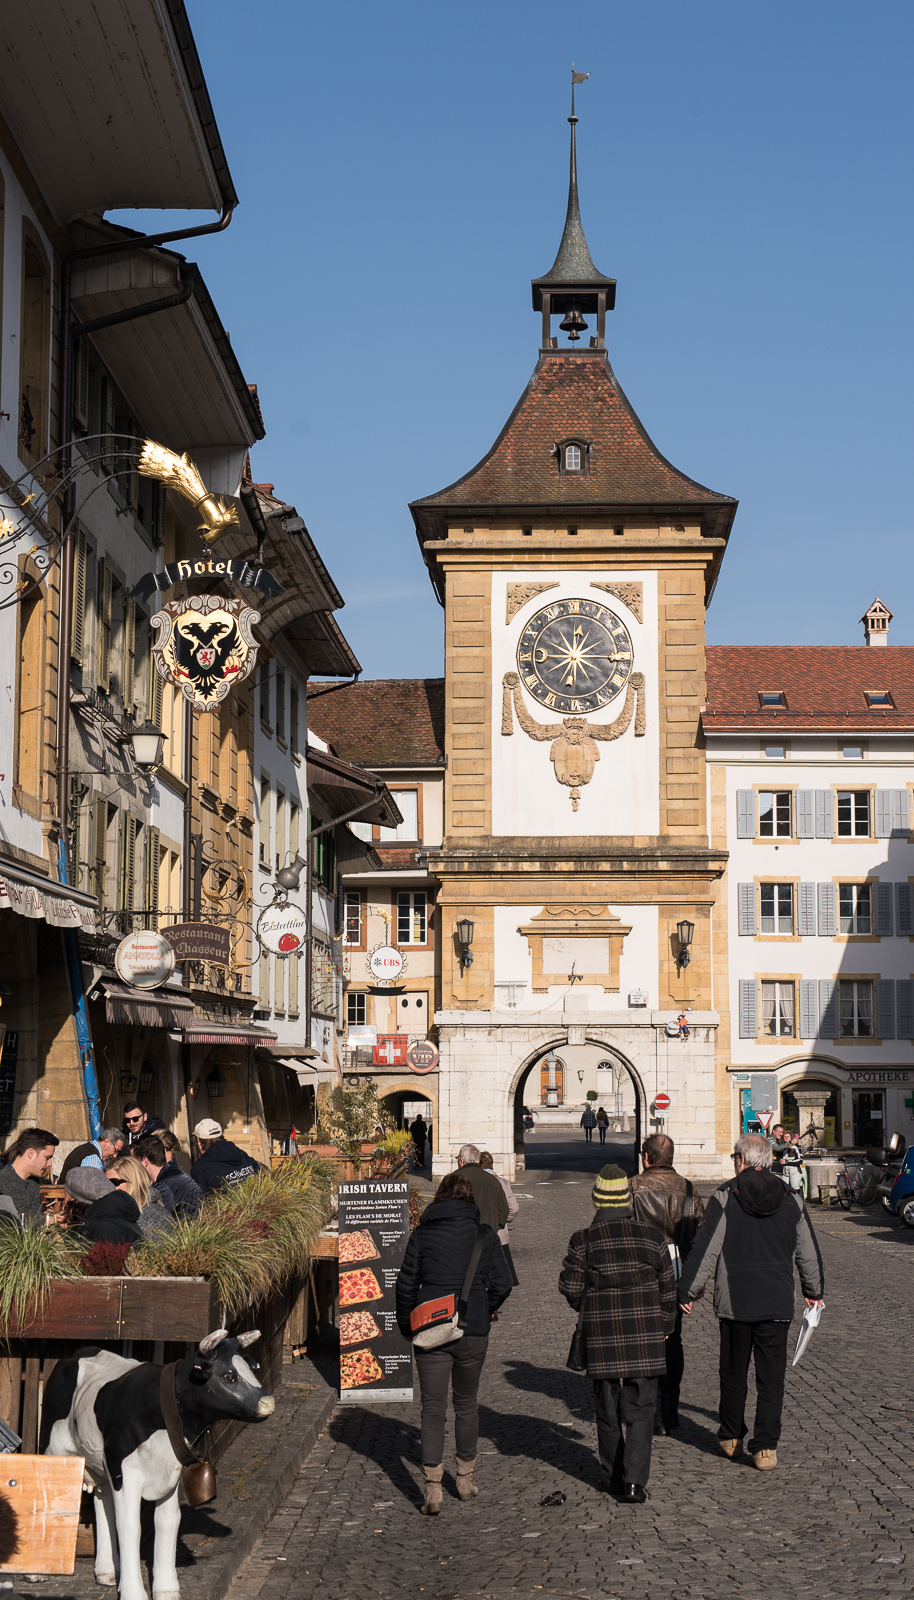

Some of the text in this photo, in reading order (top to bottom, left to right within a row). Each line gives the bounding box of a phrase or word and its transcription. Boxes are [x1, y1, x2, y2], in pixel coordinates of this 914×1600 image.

[177, 559, 234, 578] Hotel
[163, 929, 226, 944] Restaurant
[176, 941, 228, 959] Chasseur
[383, 958, 400, 967] UBS
[412, 1054, 433, 1064] VIP
[847, 1072, 910, 1082] APOTHEKE
[339, 1183, 408, 1194] IRISH TAVERN
